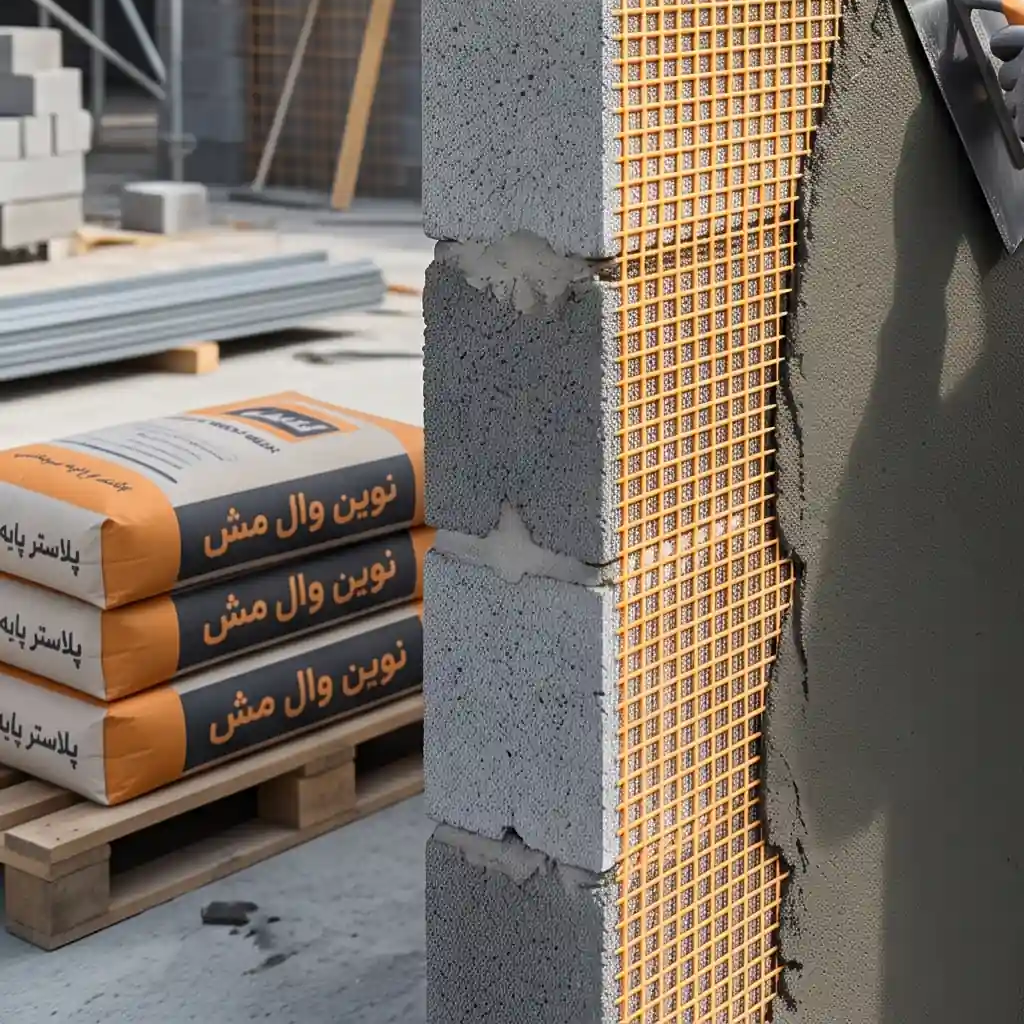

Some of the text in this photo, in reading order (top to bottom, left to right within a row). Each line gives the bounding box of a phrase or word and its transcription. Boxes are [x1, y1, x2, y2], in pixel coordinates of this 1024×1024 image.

[0, 522, 79, 576] پلاستر پایه
[204, 473, 397, 558] نوین وال مش
[203, 549, 396, 645] نوین وال مش
[0, 613, 82, 670] پلاستر پایه
[209, 639, 407, 745] نوین وال مش
[25, 724, 78, 770] پلاستر
